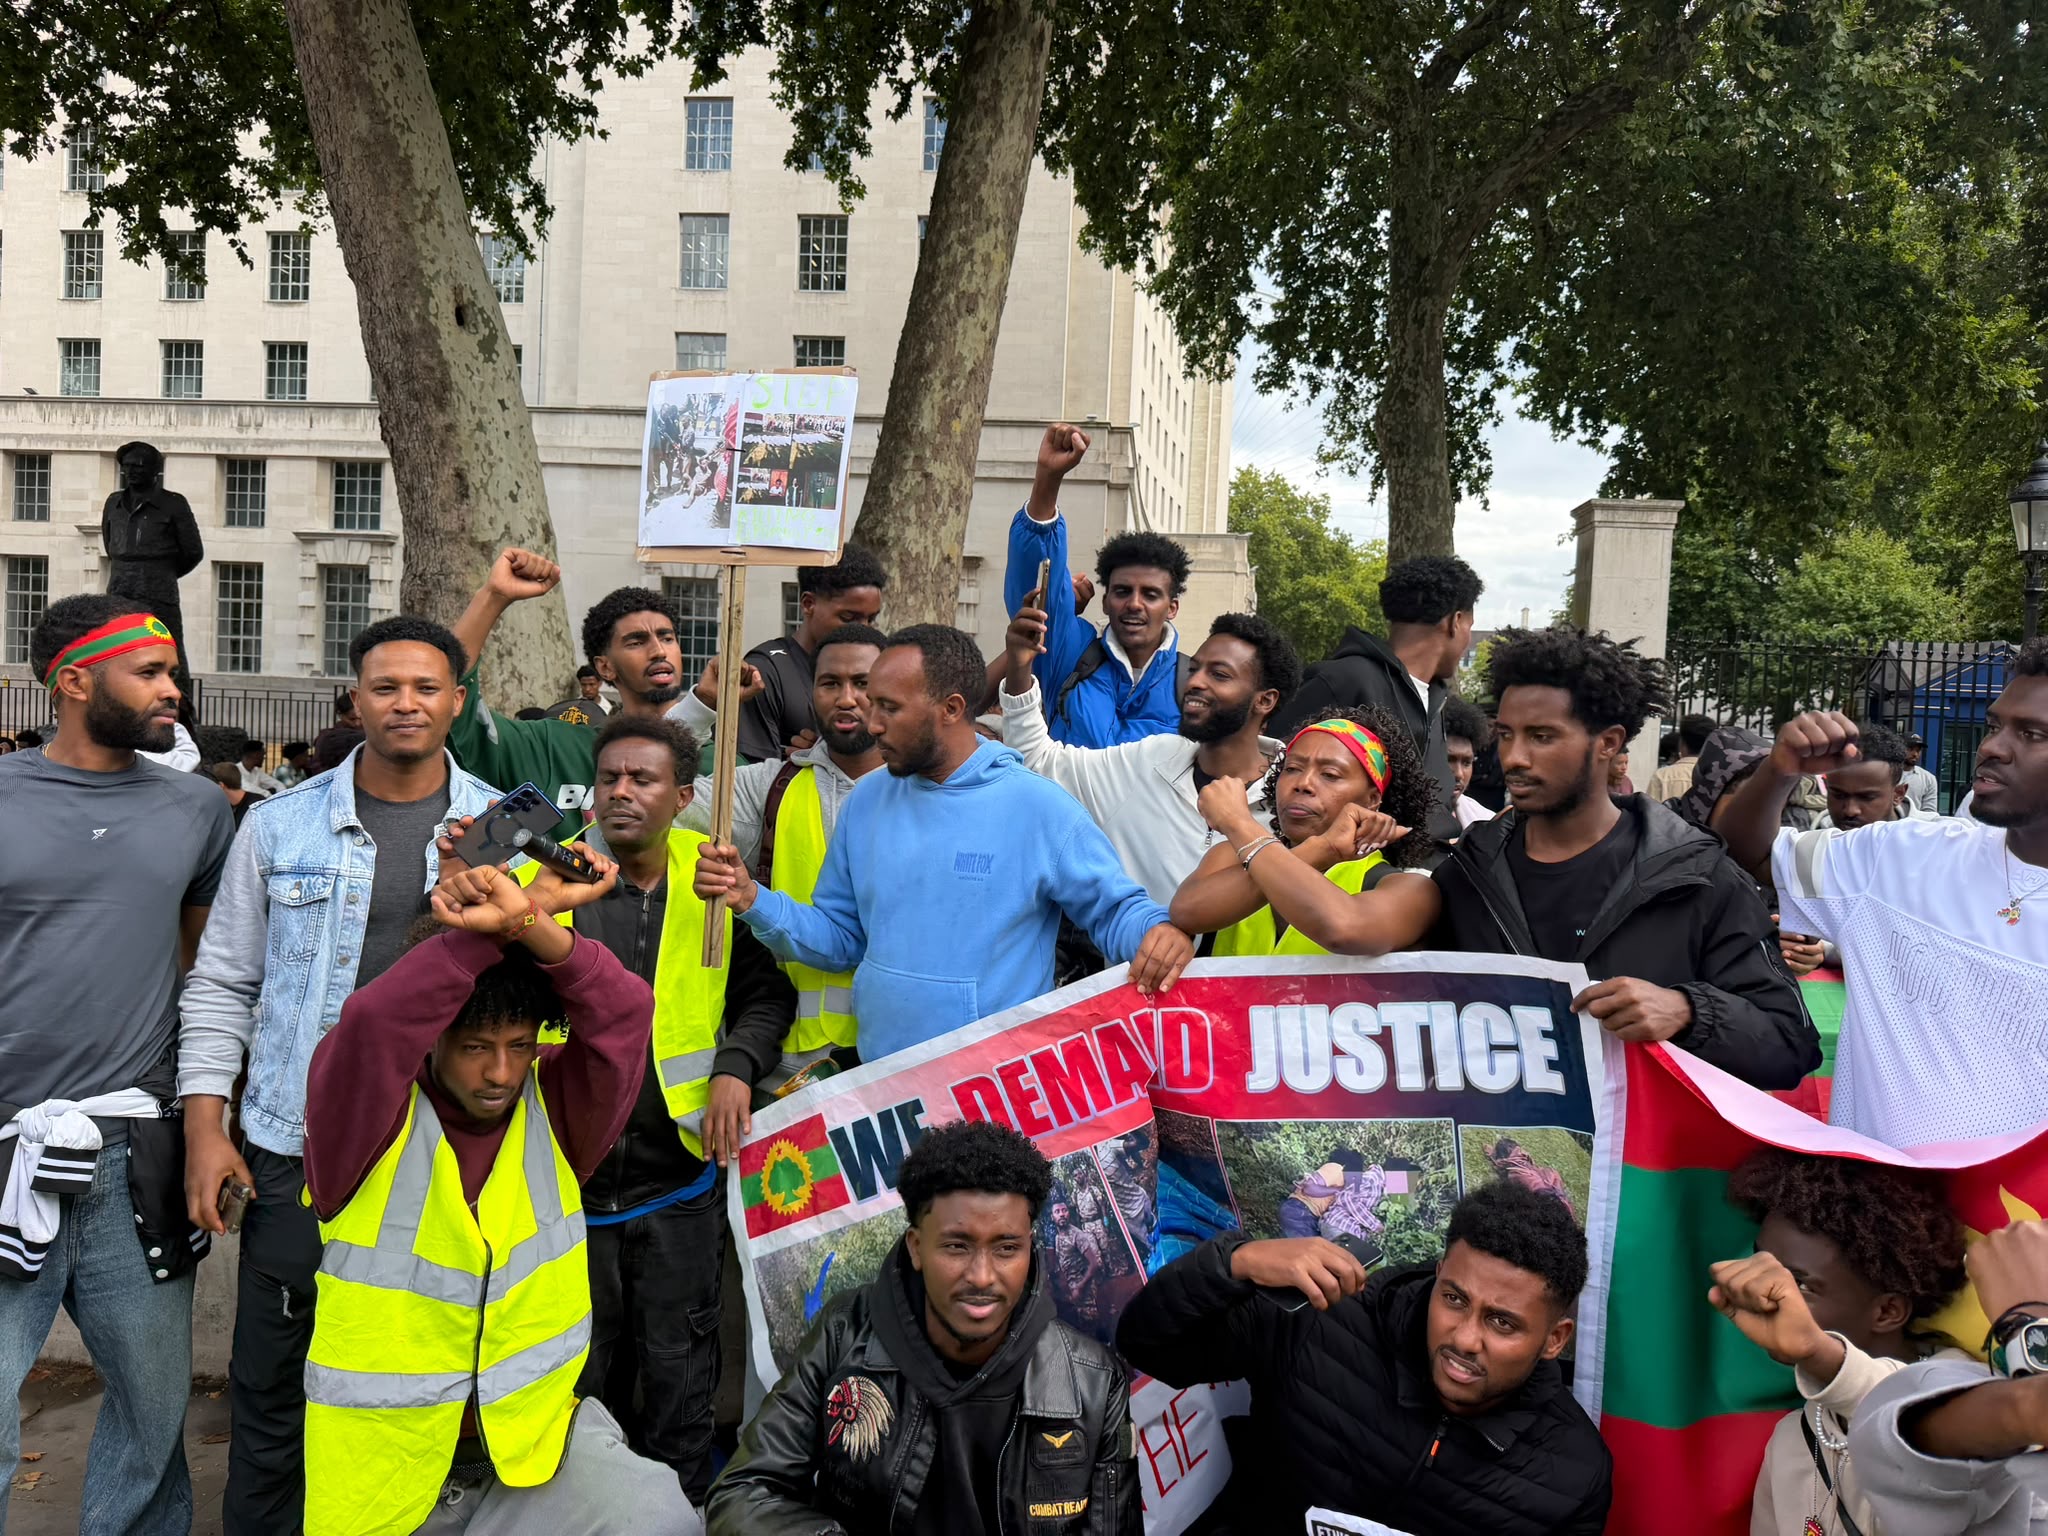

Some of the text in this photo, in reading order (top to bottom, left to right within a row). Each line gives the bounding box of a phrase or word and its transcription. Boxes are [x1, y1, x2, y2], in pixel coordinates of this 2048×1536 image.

[752, 374, 848, 411] STOP
[1888, 929, 2048, 1060] HOODRI
[826, 1095, 932, 1204] WE
[1245, 1001, 1566, 1095] JUSTICE
[1029, 1502, 1063, 1517] COMBAT
